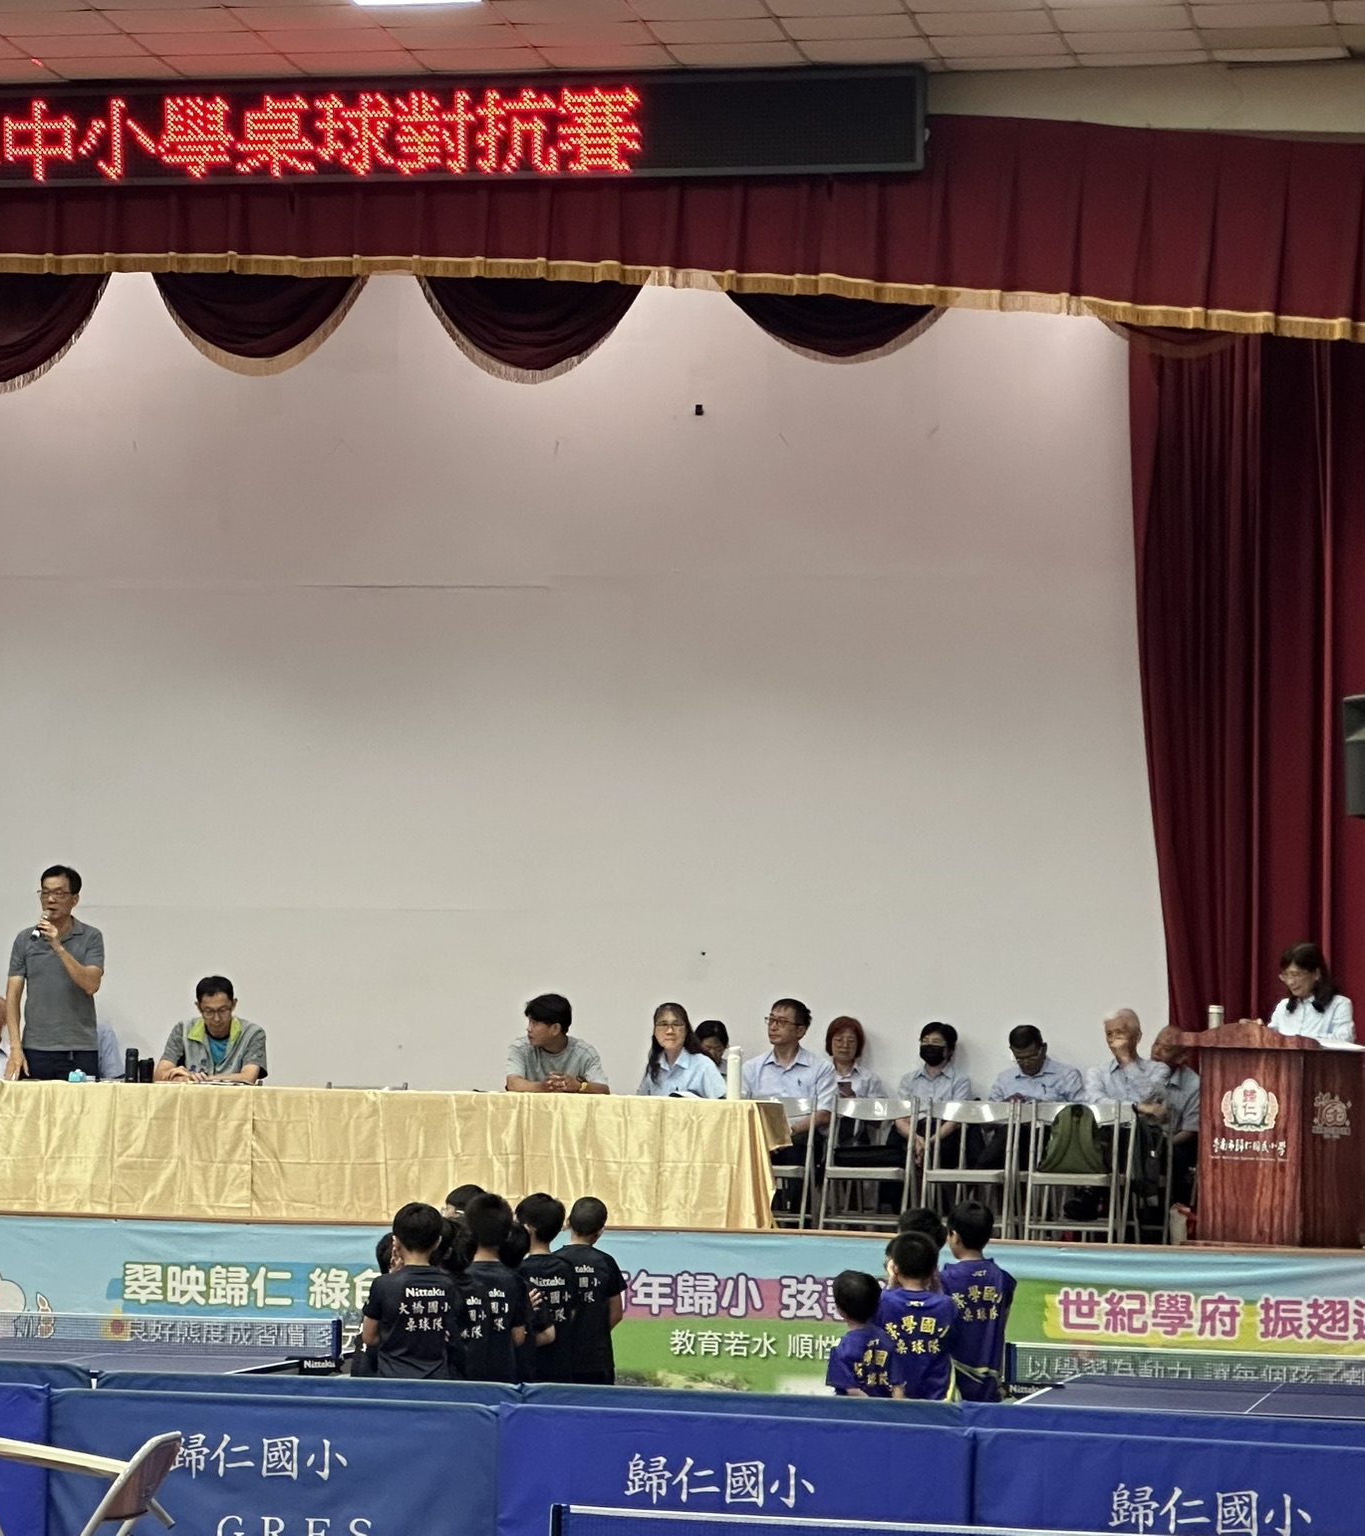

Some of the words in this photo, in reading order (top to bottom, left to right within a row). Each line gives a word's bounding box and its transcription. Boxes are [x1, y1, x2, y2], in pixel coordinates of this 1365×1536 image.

[123, 1263, 293, 1309] 翠映歸仁
[621, 1271, 764, 1317] 年歸小
[1057, 1289, 1241, 1338] 世紀學府
[669, 1329, 777, 1358] 教育若水
[169, 1433, 349, 1481] 歸仁國小
[624, 1453, 815, 1508] 歸仁國小
[1108, 1483, 1313, 1536] 歸仁國小
